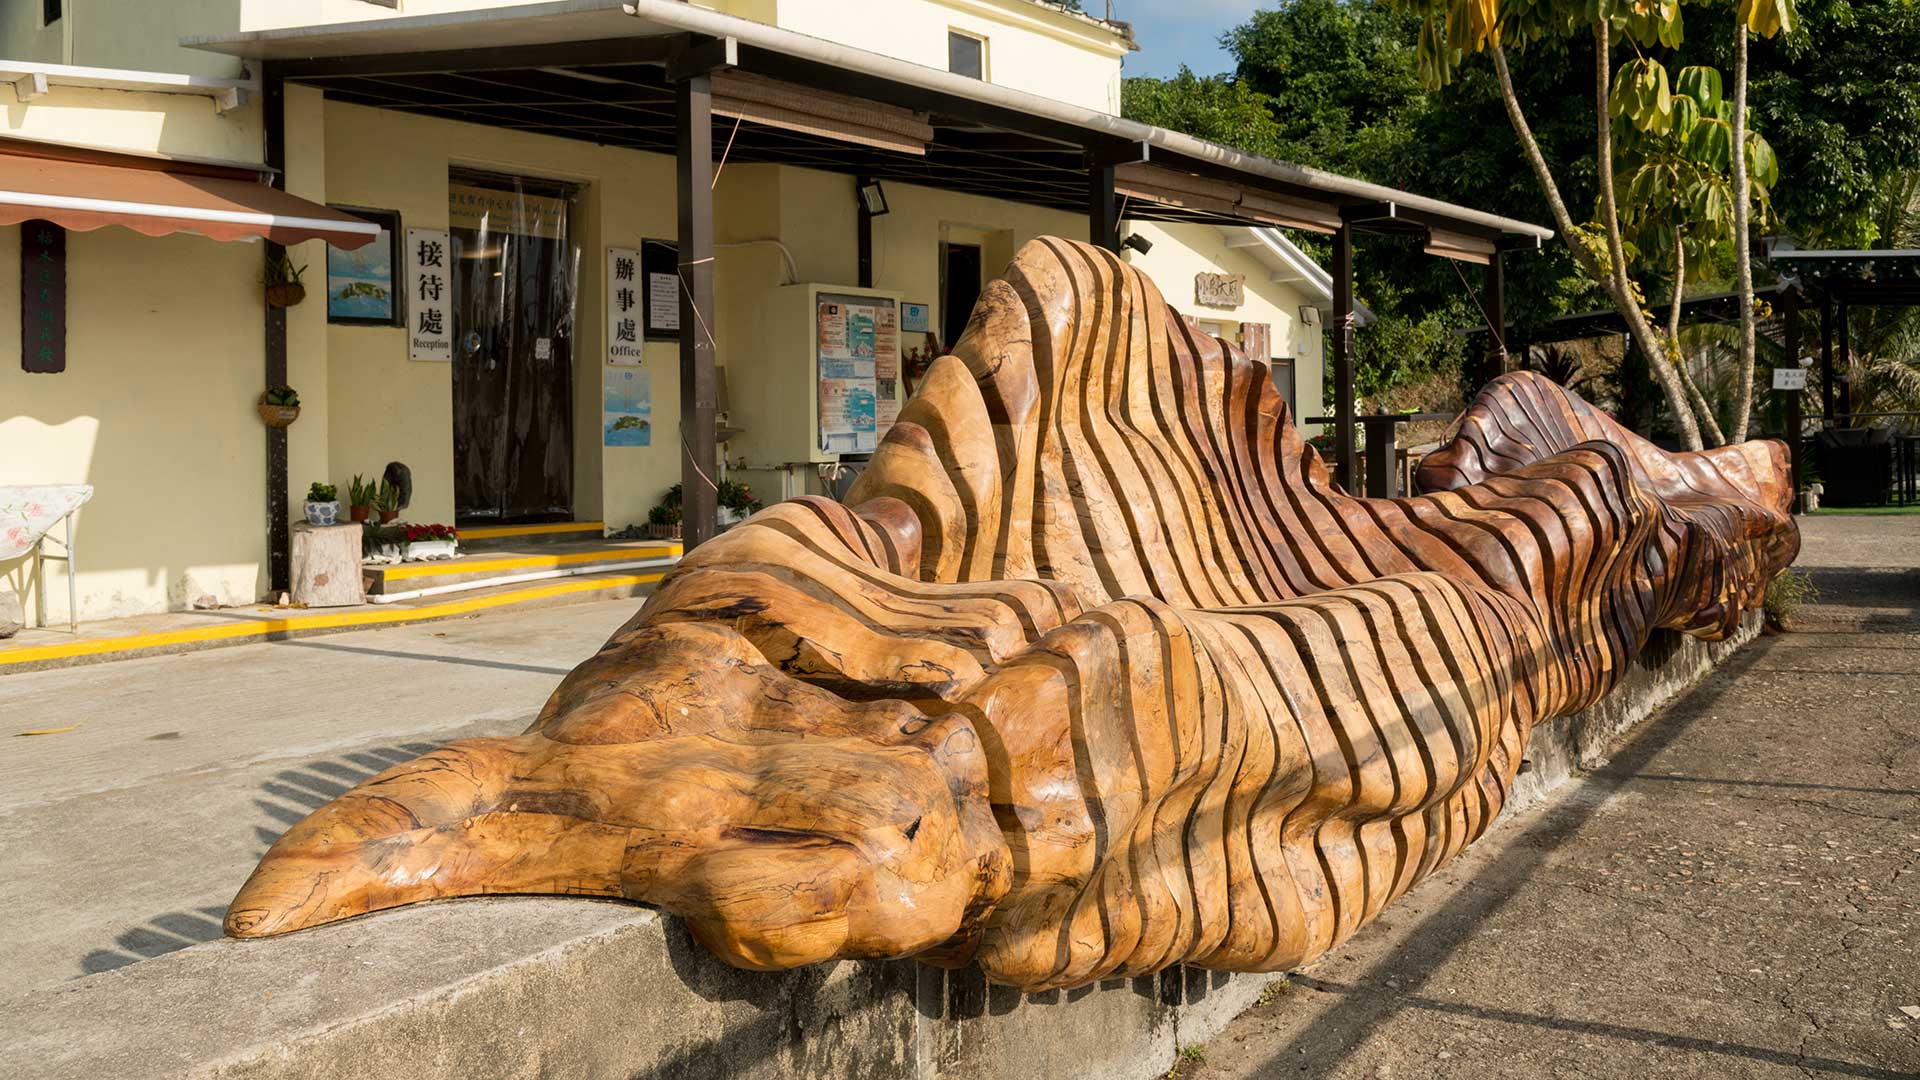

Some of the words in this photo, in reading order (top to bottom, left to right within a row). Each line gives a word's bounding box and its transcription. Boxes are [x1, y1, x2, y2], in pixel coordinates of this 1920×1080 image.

[417, 240, 443, 335] 接待處
[615, 257, 636, 342] 辦事處
[413, 338, 449, 350] Reception
[610, 345, 641, 357] Office
